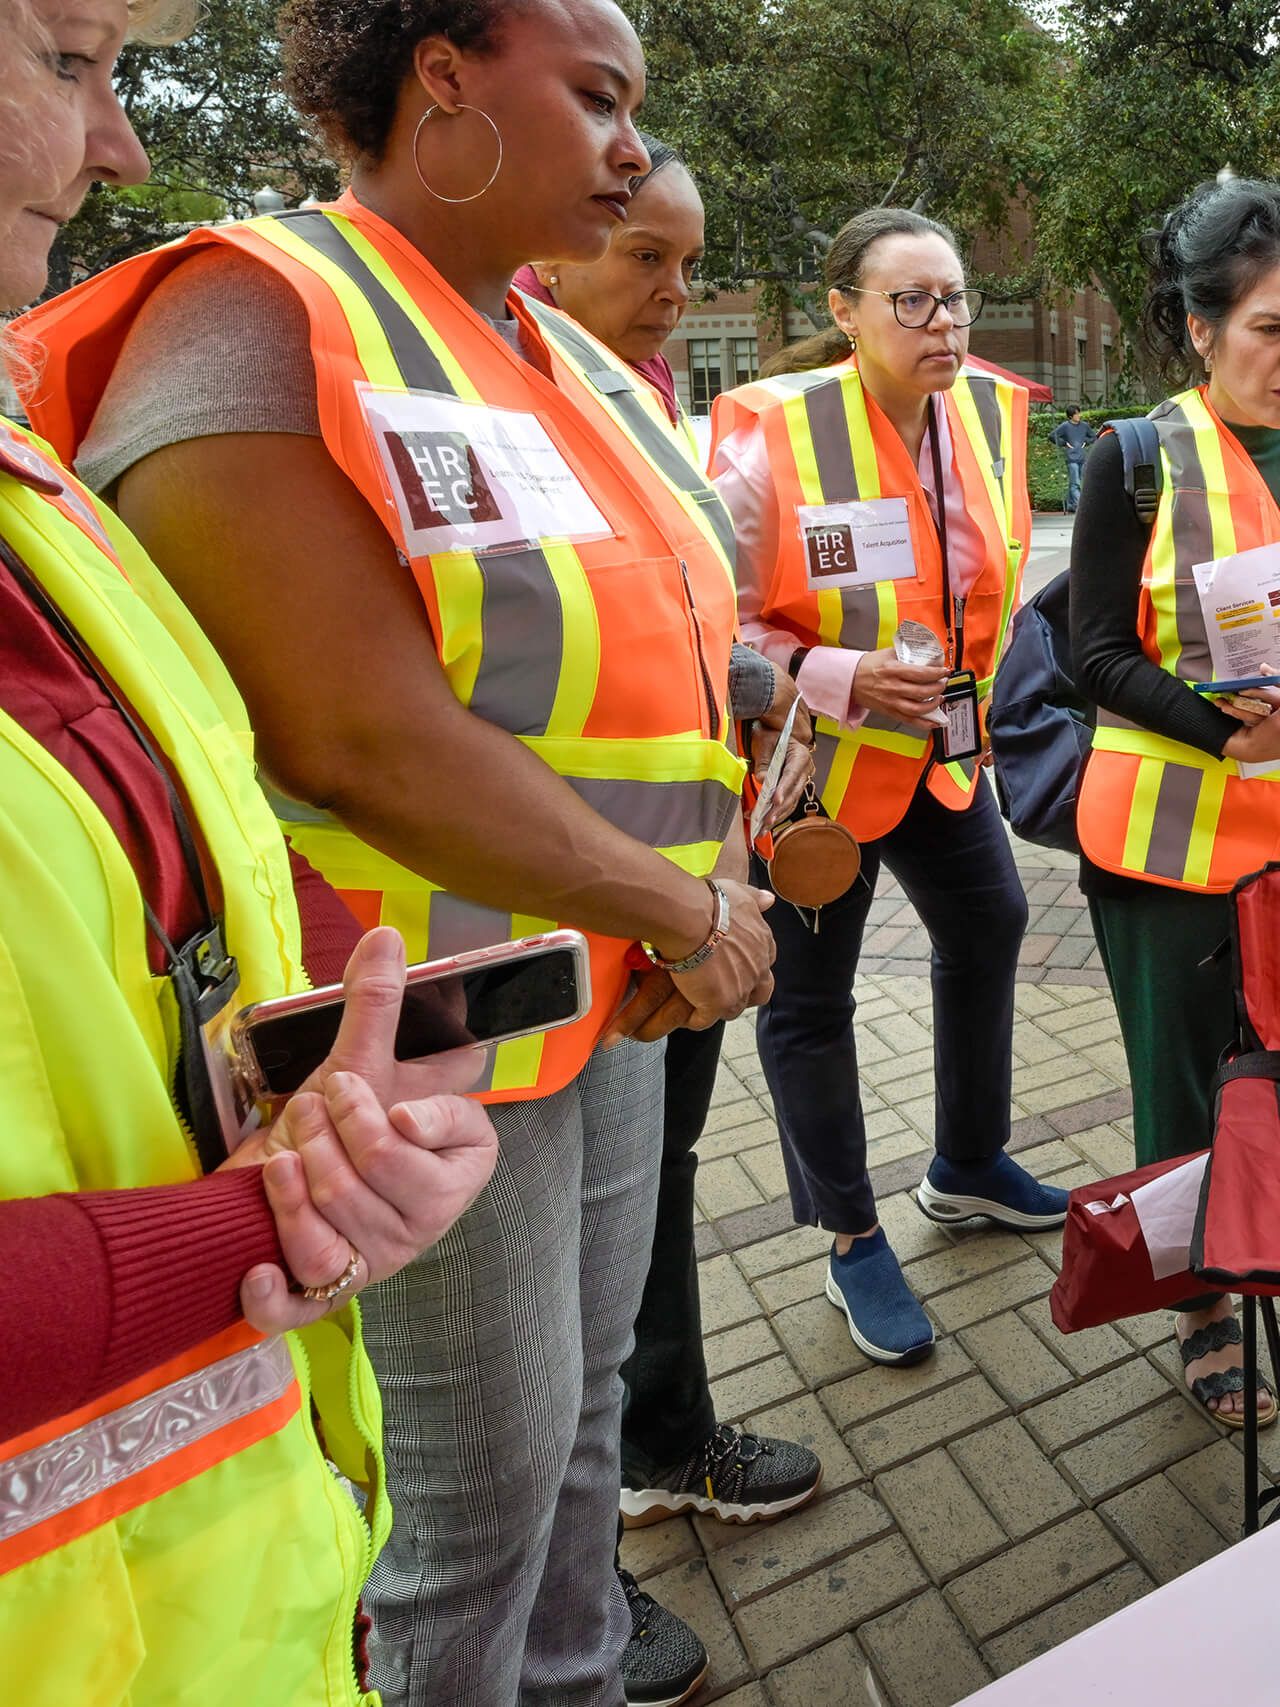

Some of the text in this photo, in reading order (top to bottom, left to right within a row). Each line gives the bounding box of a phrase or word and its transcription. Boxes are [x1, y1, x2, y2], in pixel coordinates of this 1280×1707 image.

[406, 445, 466, 477] HR
[422, 480, 478, 513] EC
[815, 532, 845, 550] HR
[880, 538, 907, 547] Acquisition
[819, 550, 848, 569] EC
[1216, 604, 1232, 613] Client
[1232, 599, 1255, 609] Services
